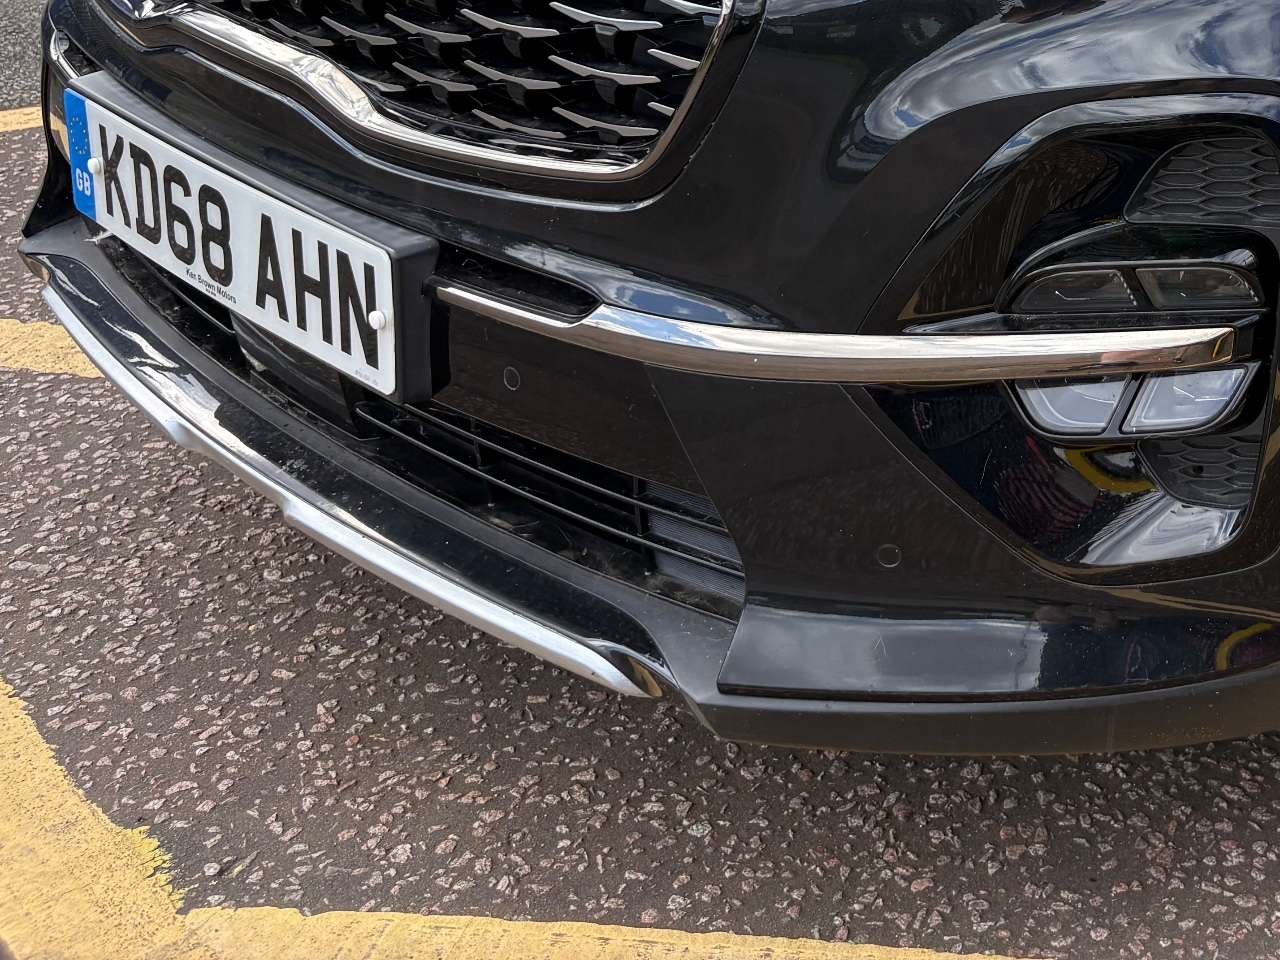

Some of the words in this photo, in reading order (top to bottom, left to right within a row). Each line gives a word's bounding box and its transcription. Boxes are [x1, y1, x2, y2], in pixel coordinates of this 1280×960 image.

[75, 167, 92, 198] GB
[98, 123, 234, 288] KD68
[255, 212, 380, 371] AHN
